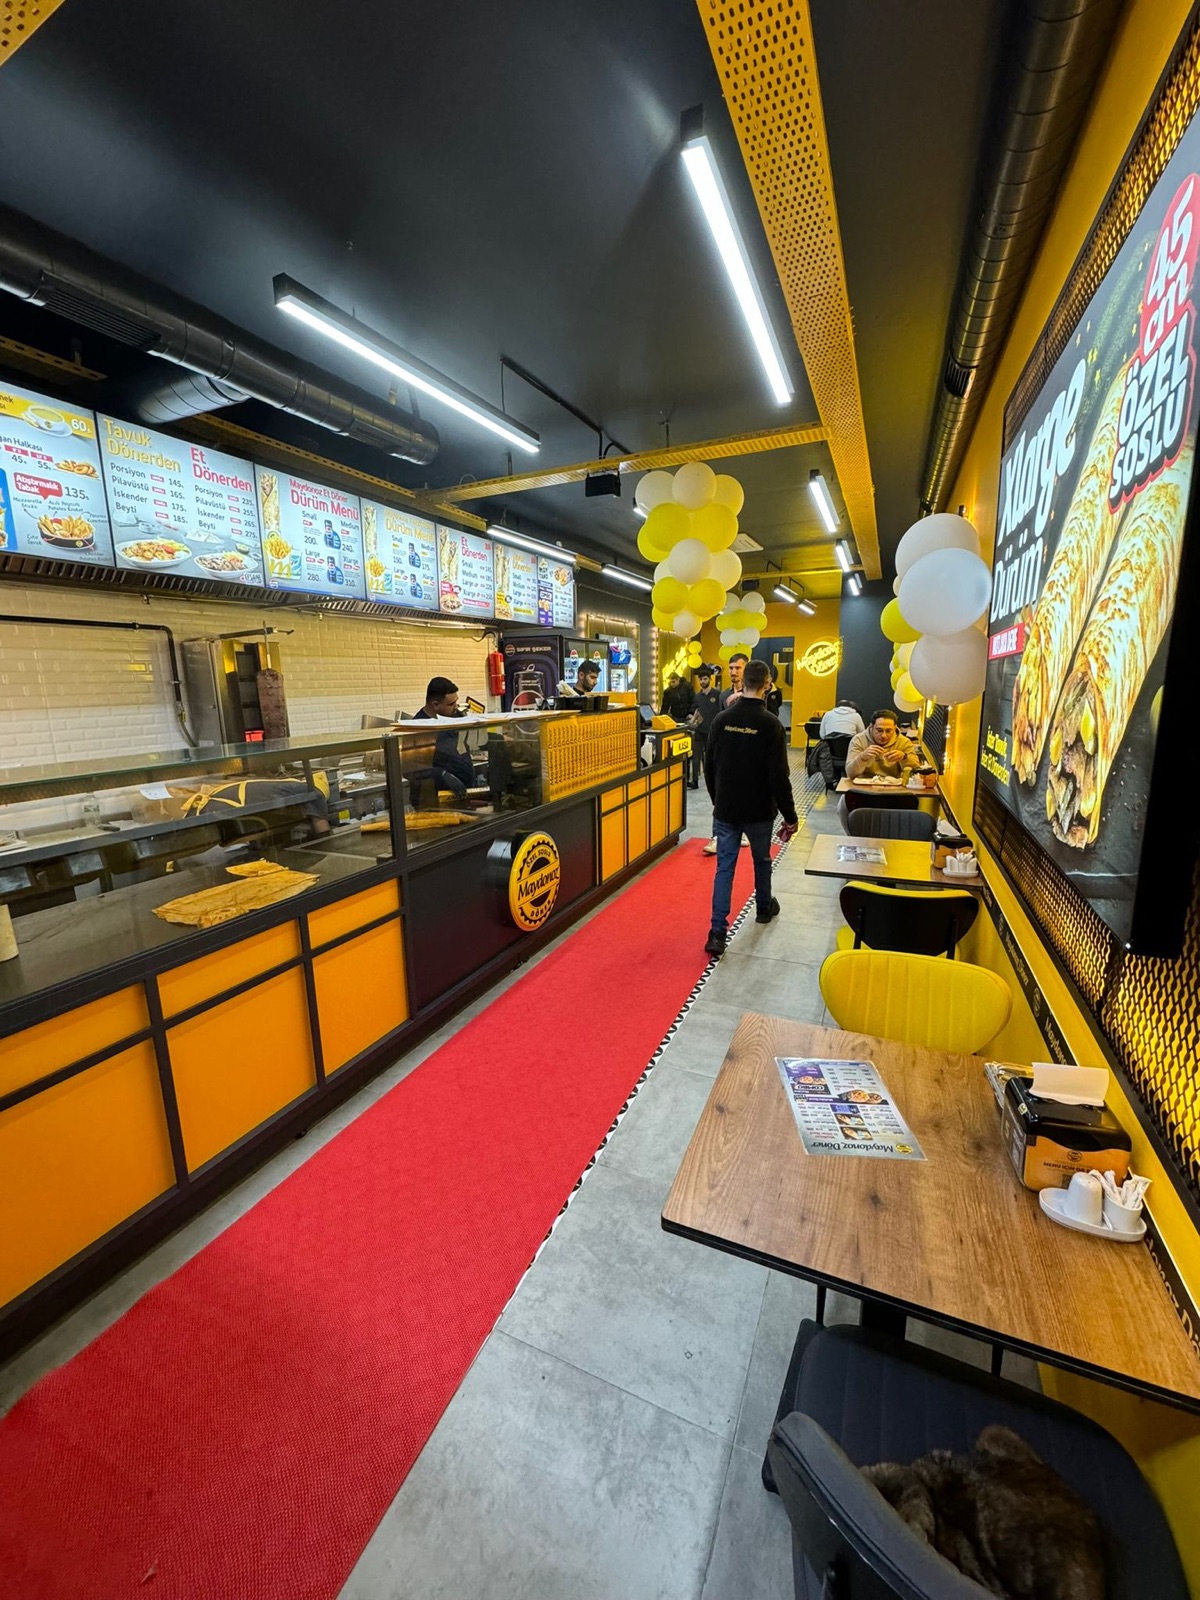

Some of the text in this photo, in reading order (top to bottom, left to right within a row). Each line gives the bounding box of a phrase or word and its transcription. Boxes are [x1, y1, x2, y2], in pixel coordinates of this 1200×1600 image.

[1147, 177, 1194, 306] 45
[1144, 262, 1188, 357] cm
[1119, 310, 1189, 445] ÖZEL
[103, 418, 151, 447] Tavuk
[1109, 378, 1187, 499] SOSLU
[13, 437, 42, 452] Halkası
[997, 358, 1086, 546] Xlarge
[107, 437, 181, 472] Dönerden
[190, 447, 206, 464] Et
[110, 462, 146, 478] Porsiyon
[193, 463, 253, 492] Dönerden
[17, 483, 39, 493] Tabak
[112, 475, 150, 491] Pilavüstü
[289, 478, 348, 503] Maydonoz Et Döner
[113, 487, 147, 503] İskender
[194, 485, 223, 498] Porsiyon
[115, 502, 137, 513] Beyti
[195, 496, 226, 510] Pilavüstü
[290, 489, 329, 512] Dürüm
[331, 501, 359, 521] Menü
[197, 508, 225, 521] İskender
[302, 510, 317, 520] Small
[198, 520, 216, 530] Beyti
[340, 520, 360, 530] Medium
[461, 536, 468, 547] Et
[305, 548, 321, 558] Large
[461, 546, 488, 561] Dönerden
[462, 560, 473, 568] Small
[990, 528, 1044, 624] Dürüm
[525, 853, 538, 868] ÖZEL
[518, 867, 559, 901] Maydonoz
[530, 899, 551, 917] DÖNER
[811, 1141, 893, 1153] Maydonoz Döner
